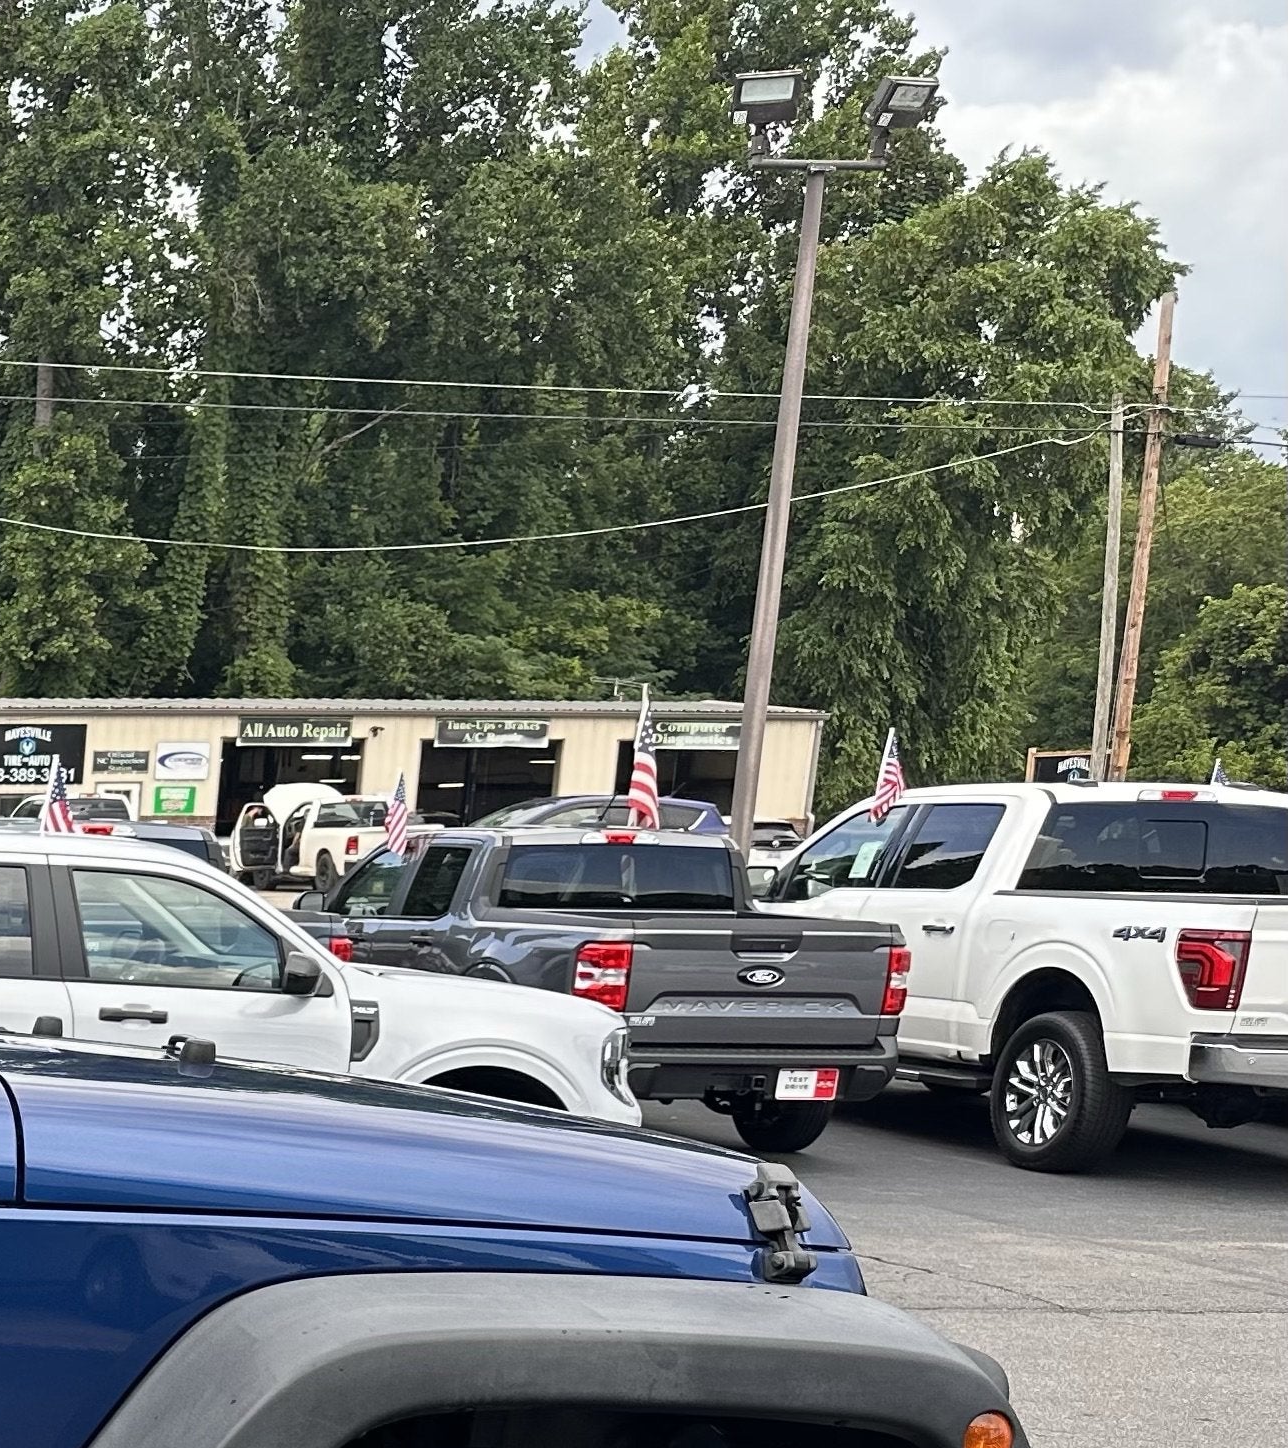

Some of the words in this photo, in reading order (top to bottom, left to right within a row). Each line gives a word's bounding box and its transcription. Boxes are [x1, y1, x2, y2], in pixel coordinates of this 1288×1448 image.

[241, 723, 263, 738] All
[265, 723, 298, 738] Auto
[301, 723, 348, 741] Repair
[447, 720, 496, 733] Tune-Ups
[504, 721, 540, 731] Brakes
[655, 721, 730, 735] Computer
[4, 726, 52, 742] HAYESVILLE
[651, 733, 733, 746] Diagnostics
[3, 754, 22, 767] TIRE
[27, 754, 51, 767] AUTO
